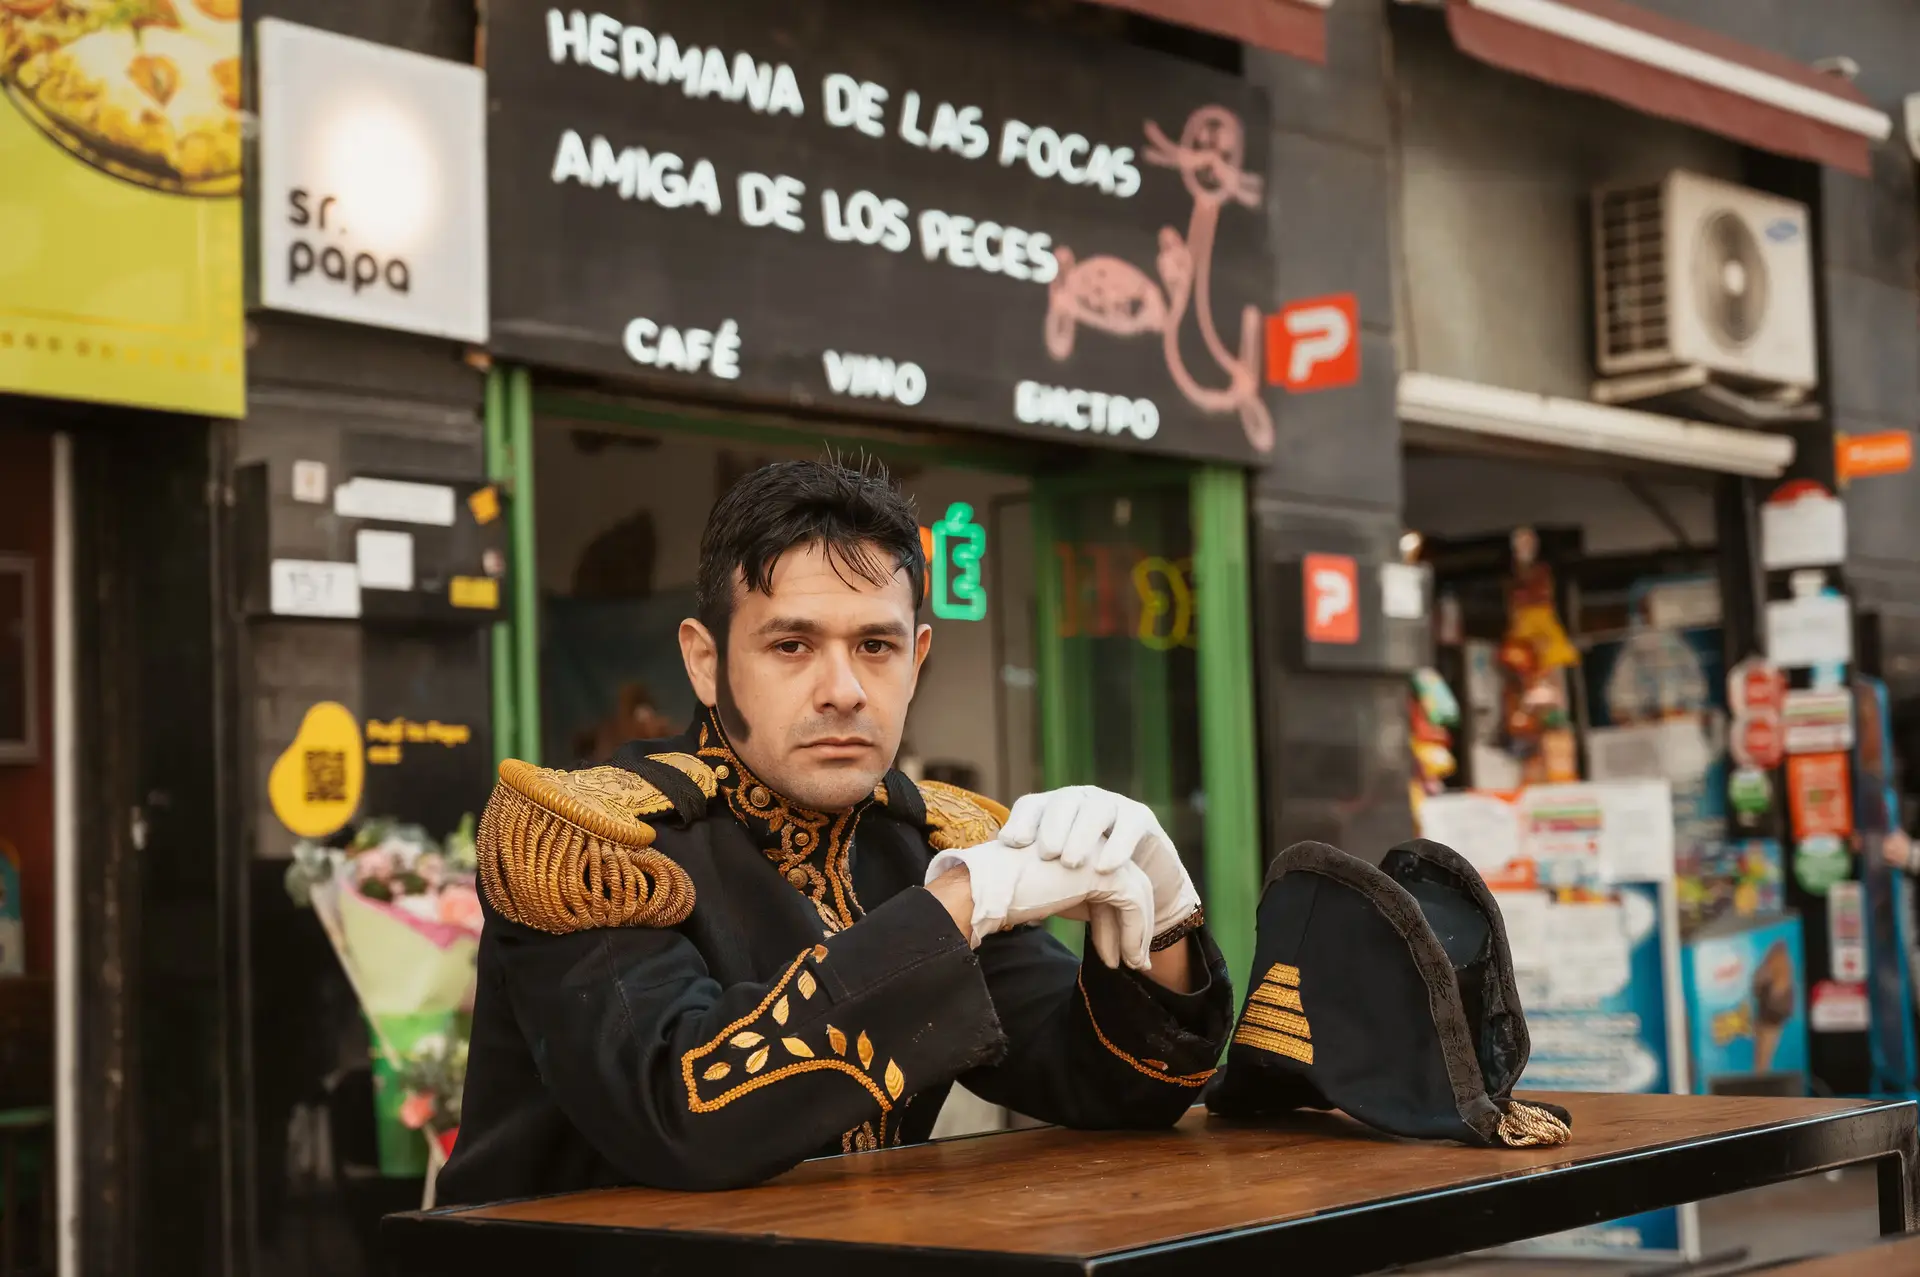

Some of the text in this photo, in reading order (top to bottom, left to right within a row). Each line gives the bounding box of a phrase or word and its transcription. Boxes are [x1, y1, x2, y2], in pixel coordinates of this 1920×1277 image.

[547, 9, 1142, 198] HERMANA DE LAS FOCAS
[553, 130, 1058, 284] AMIGA DE LOS PECES
[288, 240, 410, 295] papa
[624, 317, 742, 380] CAFÉ
[822, 349, 928, 406] VINO
